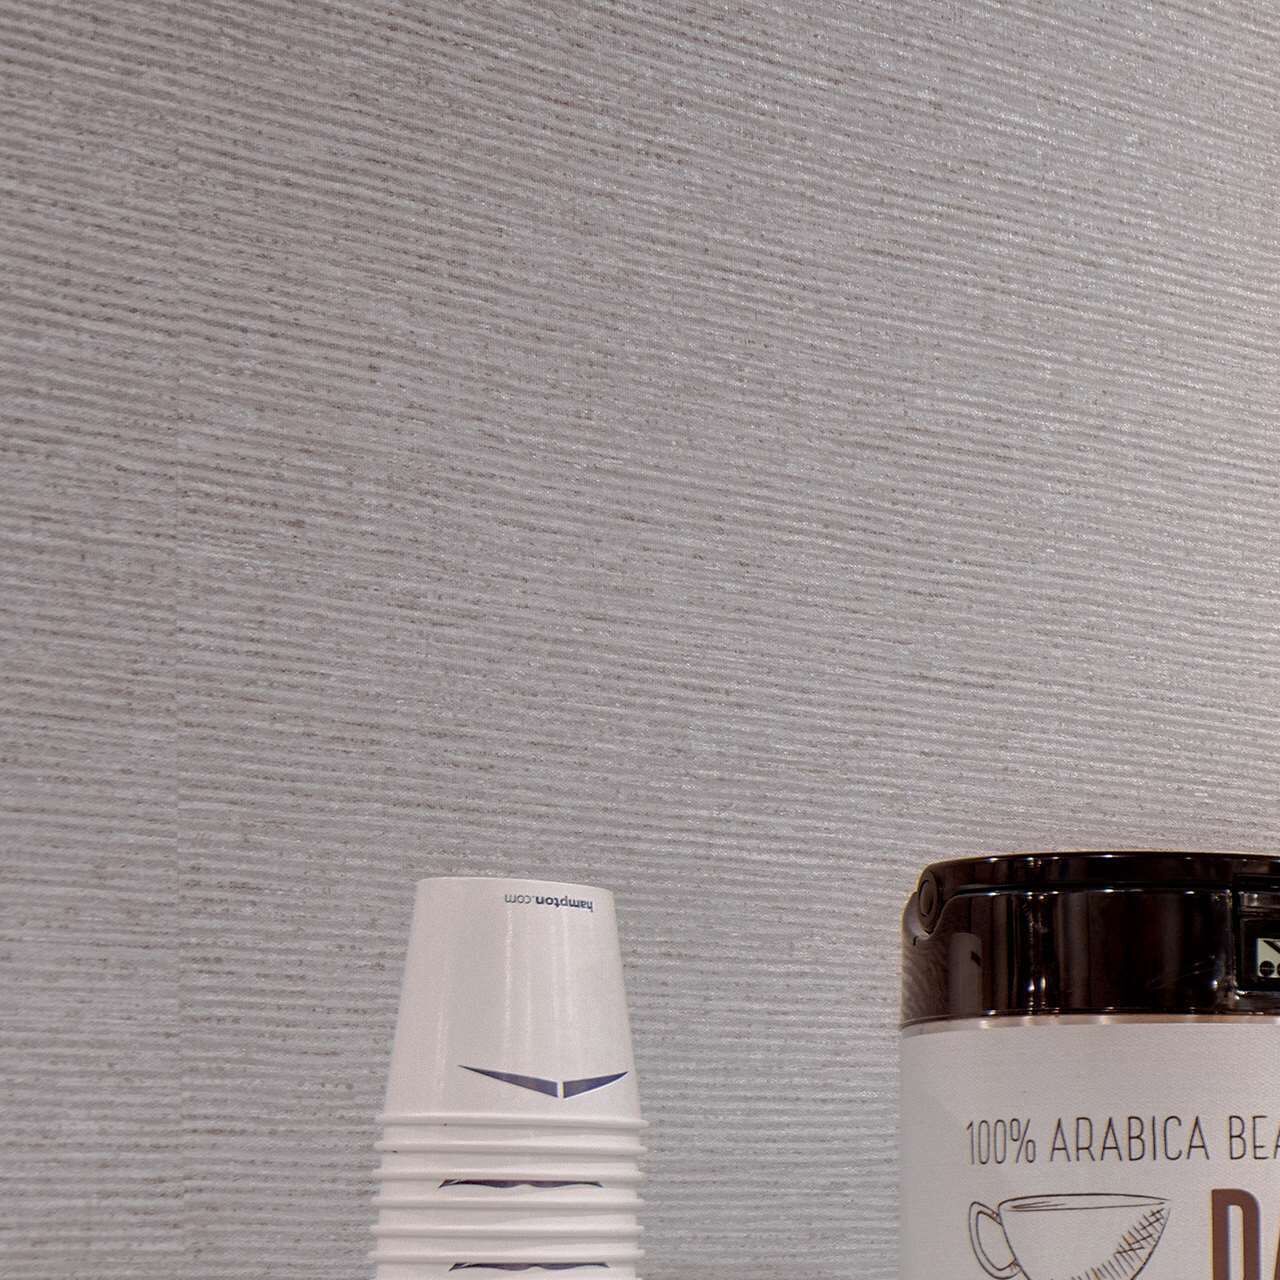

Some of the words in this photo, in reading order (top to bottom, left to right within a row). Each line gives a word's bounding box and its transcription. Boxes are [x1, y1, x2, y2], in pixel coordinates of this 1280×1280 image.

[504, 894, 593, 912] hampton.com
[966, 1118, 1036, 1165] 100%
[1050, 1116, 1209, 1162] ARABICA
